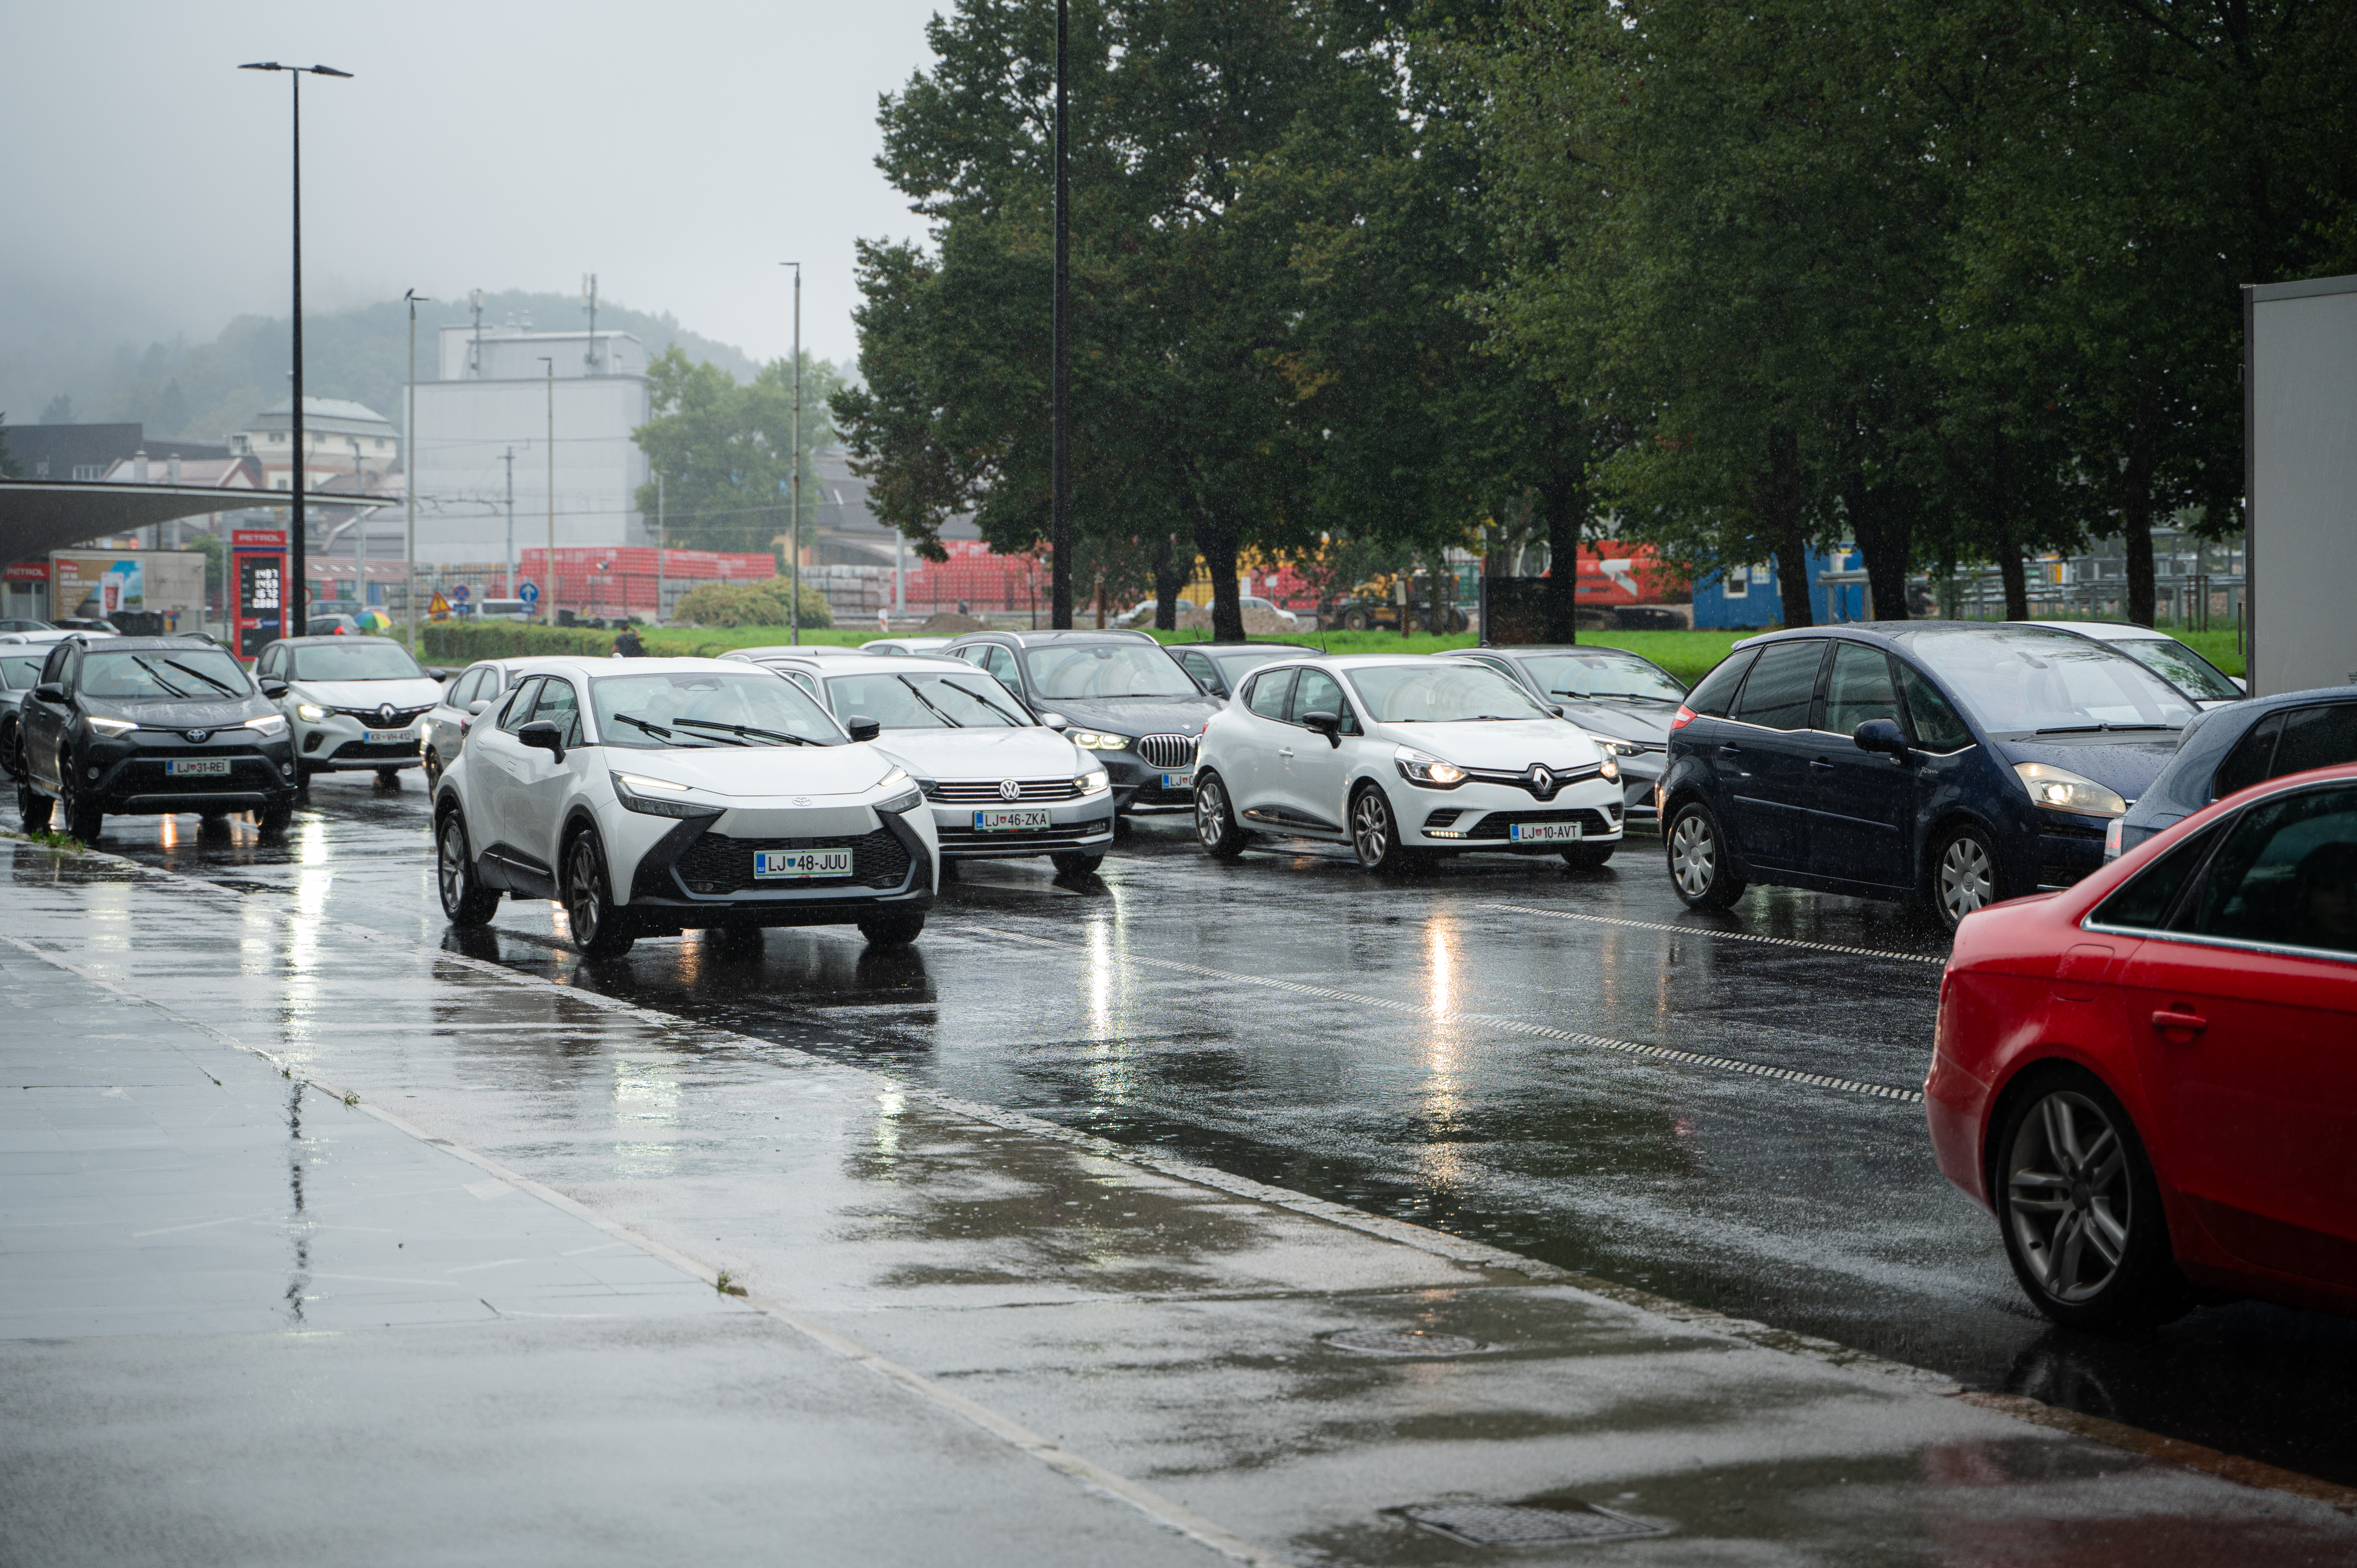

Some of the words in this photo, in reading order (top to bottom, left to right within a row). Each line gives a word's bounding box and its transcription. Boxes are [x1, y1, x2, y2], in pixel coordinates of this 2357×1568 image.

[7, 568, 45, 576] PETROL
[178, 763, 189, 772] LJ
[197, 762, 224, 772] 31-REI
[1170, 776, 1181, 786] LJ
[986, 814, 999, 826] LJ
[1008, 813, 1047, 826] 46-ZKA
[1522, 827, 1535, 839] LJ
[1543, 825, 1577, 839] 10-AVT
[769, 856, 785, 872] LJ
[797, 854, 847, 871] 48-JUU
